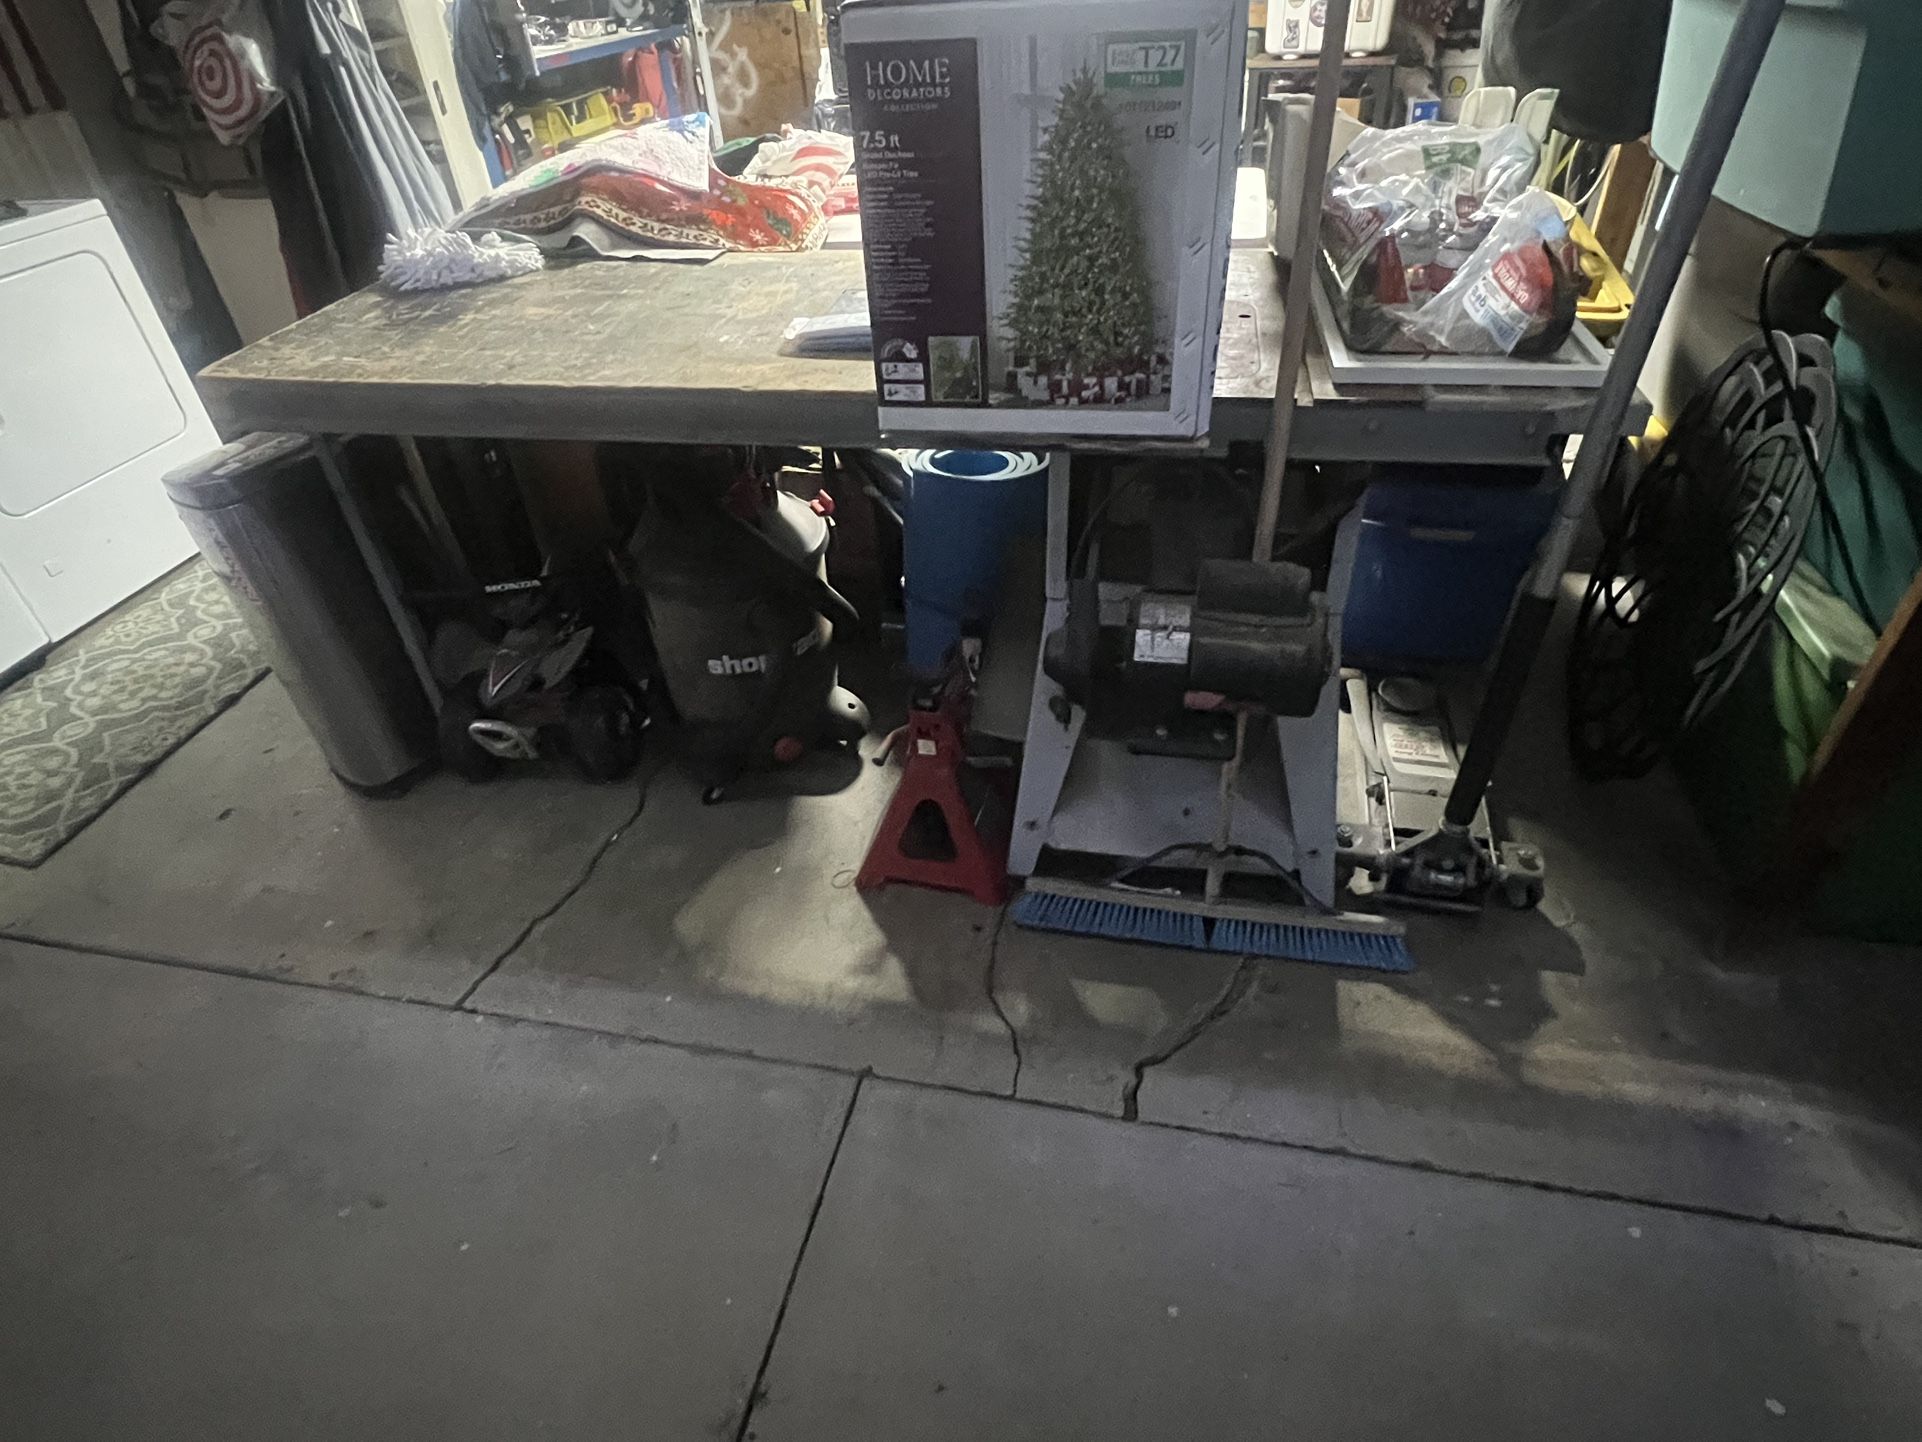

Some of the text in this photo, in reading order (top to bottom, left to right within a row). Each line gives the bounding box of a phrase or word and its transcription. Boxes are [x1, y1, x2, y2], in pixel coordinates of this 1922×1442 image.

[1138, 44, 1182, 68] T27
[865, 58, 951, 85] HOME
[867, 86, 951, 100] DECORATORS
[860, 130, 900, 149] 7.5 ft
[1145, 124, 1176, 139] LED
[484, 578, 543, 594] HONDA
